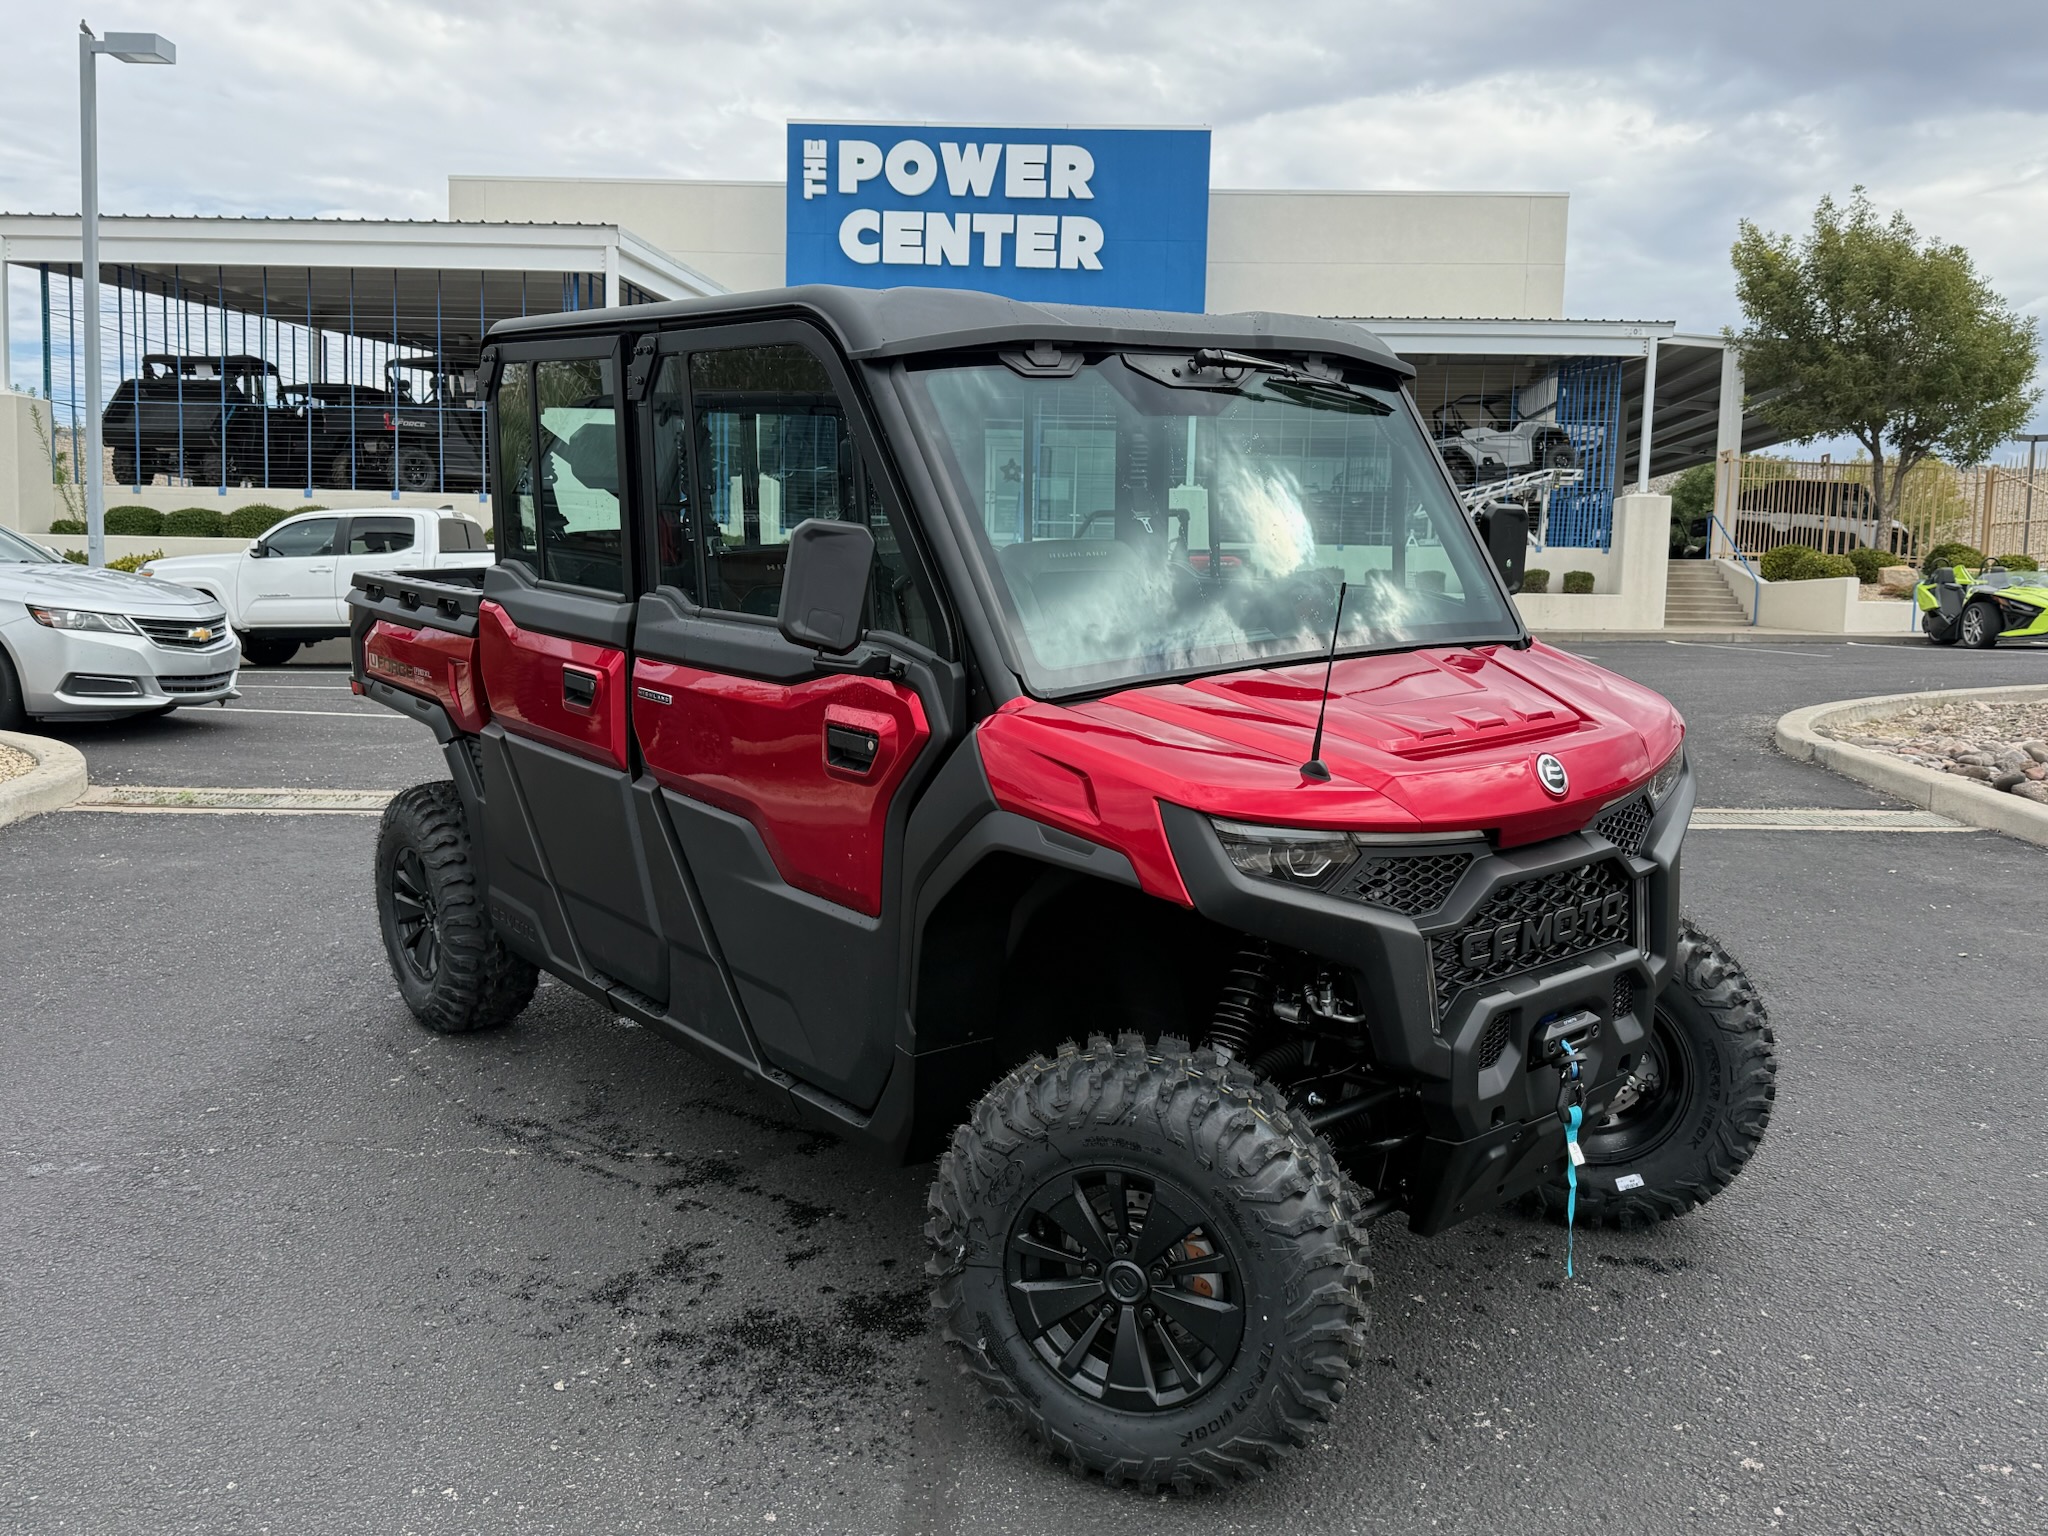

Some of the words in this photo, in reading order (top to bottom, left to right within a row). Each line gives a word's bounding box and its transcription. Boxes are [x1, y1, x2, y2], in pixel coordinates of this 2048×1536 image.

[803, 139, 827, 200] THE
[838, 139, 1095, 199] POWER
[838, 208, 1105, 270] CENTER
[1461, 891, 1623, 968] CFMOTO
